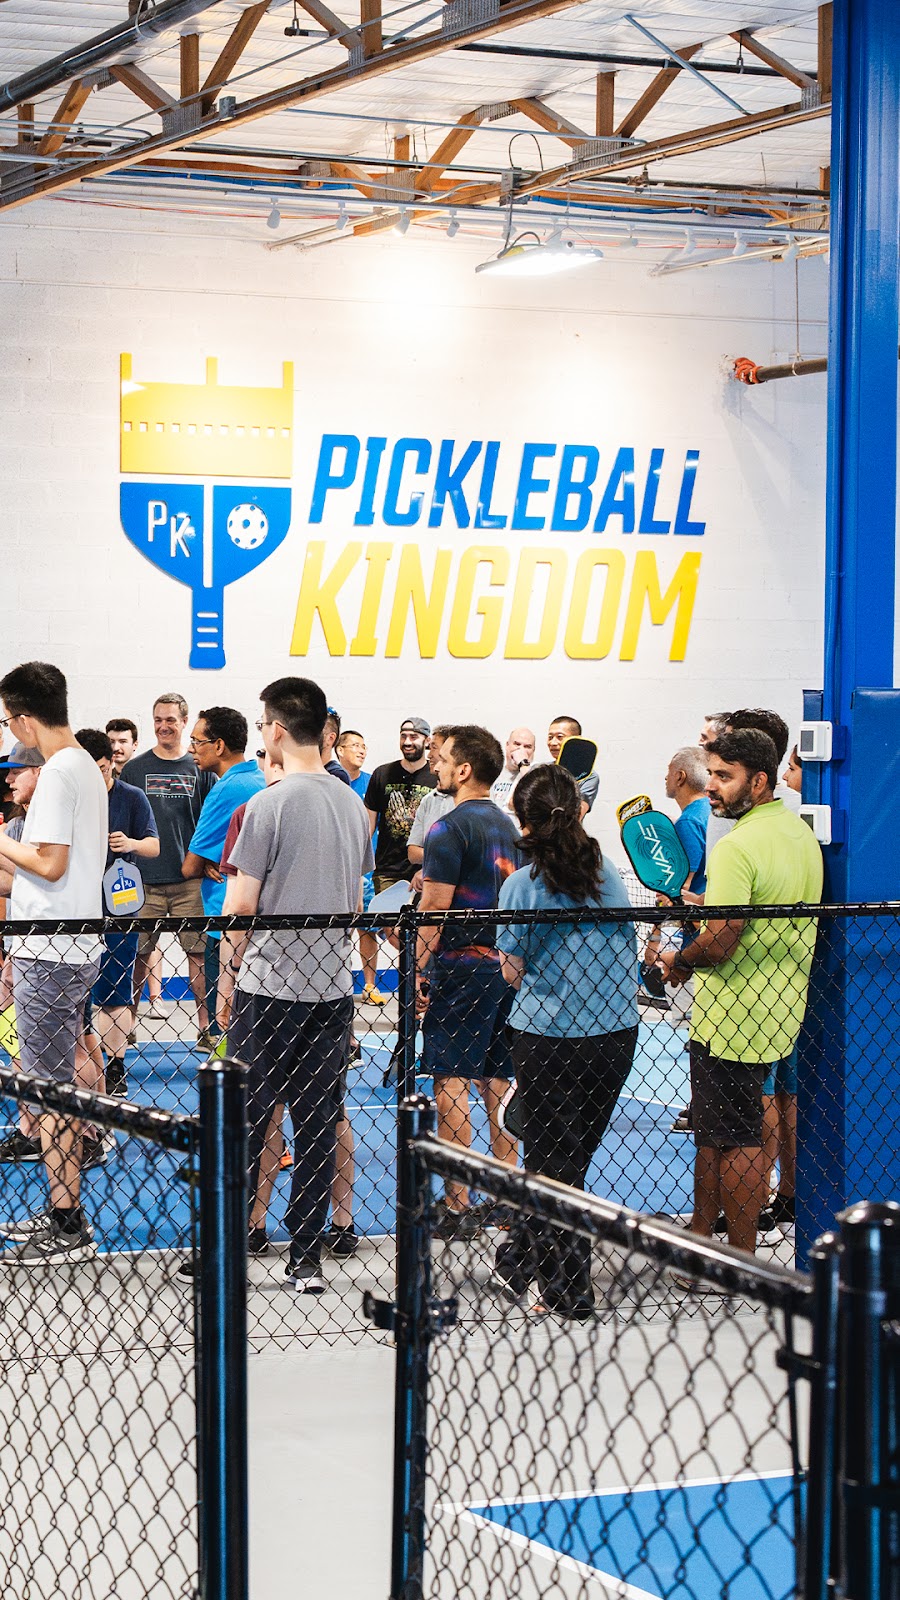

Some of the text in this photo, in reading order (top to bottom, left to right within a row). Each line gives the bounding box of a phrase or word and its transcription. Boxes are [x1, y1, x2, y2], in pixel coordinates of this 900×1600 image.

[308, 434, 706, 535] PICKLEBALL
[148, 500, 192, 558] PK
[289, 541, 702, 661] KINGDOM
[637, 820, 675, 886] WAVE
